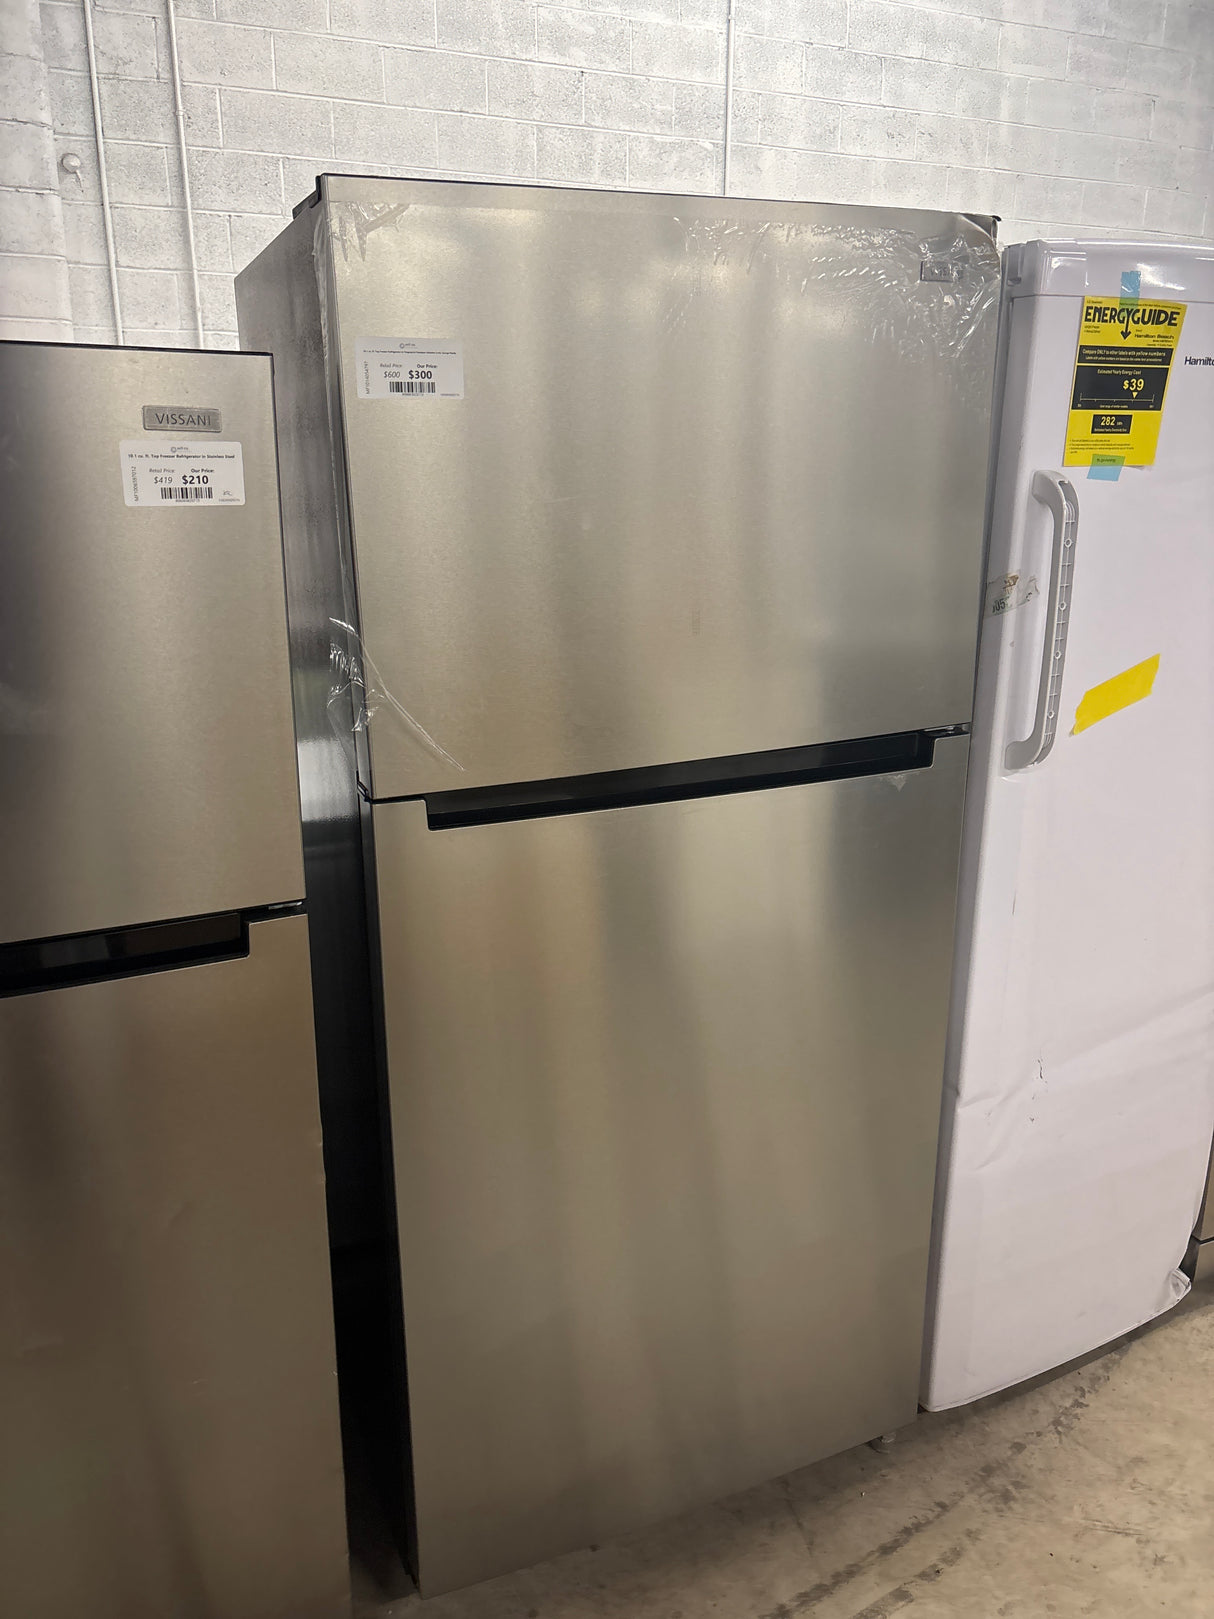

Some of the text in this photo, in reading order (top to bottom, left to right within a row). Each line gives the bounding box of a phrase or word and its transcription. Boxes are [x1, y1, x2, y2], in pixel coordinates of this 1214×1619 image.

[1084, 305, 1180, 327] ENERGYGUIDE
[383, 370, 401, 379] $600
[408, 369, 433, 380] $300
[1123, 378, 1145, 391] $39
[155, 412, 212, 426] VISSANI
[1100, 416, 1116, 426] 282
[153, 476, 173, 485] $419
[181, 474, 209, 486] $210
